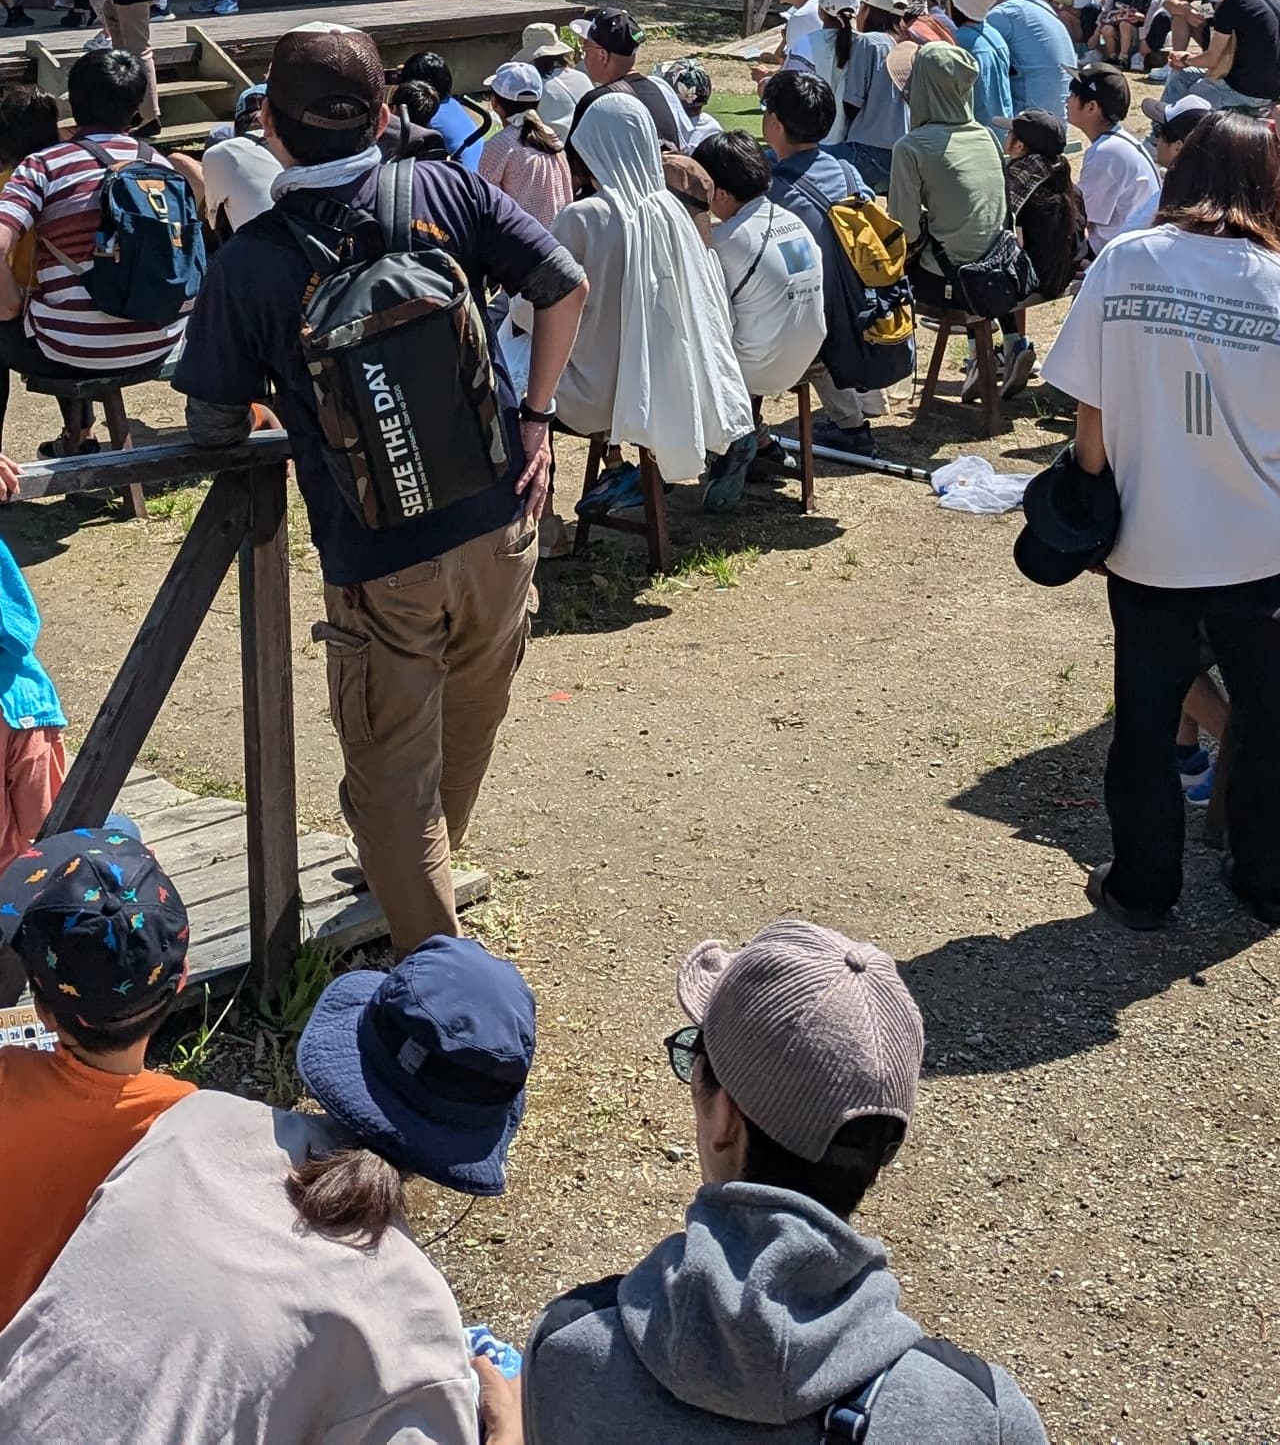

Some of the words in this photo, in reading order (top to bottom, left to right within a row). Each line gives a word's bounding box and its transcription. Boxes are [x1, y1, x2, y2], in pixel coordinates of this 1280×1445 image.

[1129, 283, 1144, 291] THE
[1145, 283, 1174, 293] BRAND
[1175, 287, 1198, 298] WITH
[1199, 292, 1214, 303] THE
[1216, 296, 1244, 308] THREE
[1104, 299, 1143, 317] THE
[1145, 300, 1213, 327] THREE
[1197, 333, 1214, 345] DEN
[362, 362, 395, 413] DAY
[379, 414, 409, 462] THE
[392, 461, 424, 517] SEIZE
[10, 1032, 20, 1040] 26
